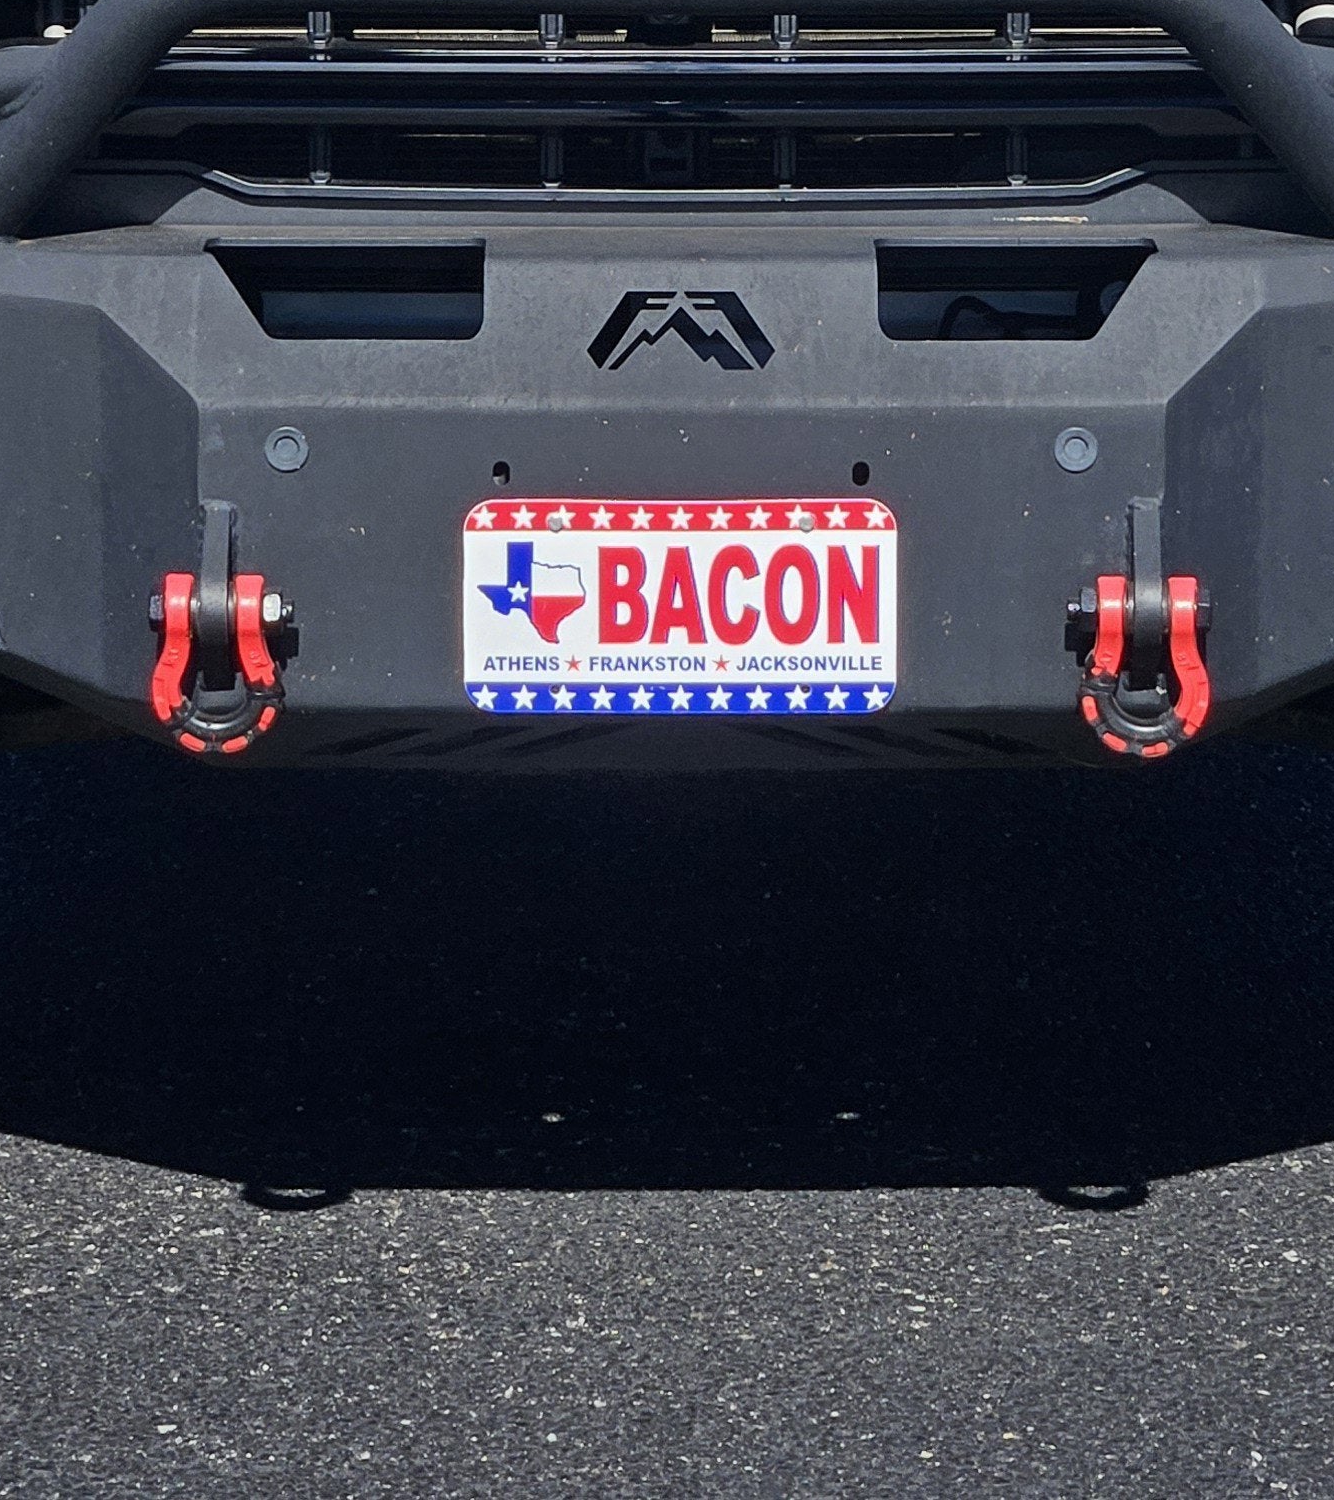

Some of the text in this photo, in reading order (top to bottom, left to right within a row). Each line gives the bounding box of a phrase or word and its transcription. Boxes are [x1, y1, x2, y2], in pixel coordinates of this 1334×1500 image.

[598, 543, 880, 645] BACON
[483, 656, 882, 672] ATHENS FRANKSTON JACKSONVILLE
